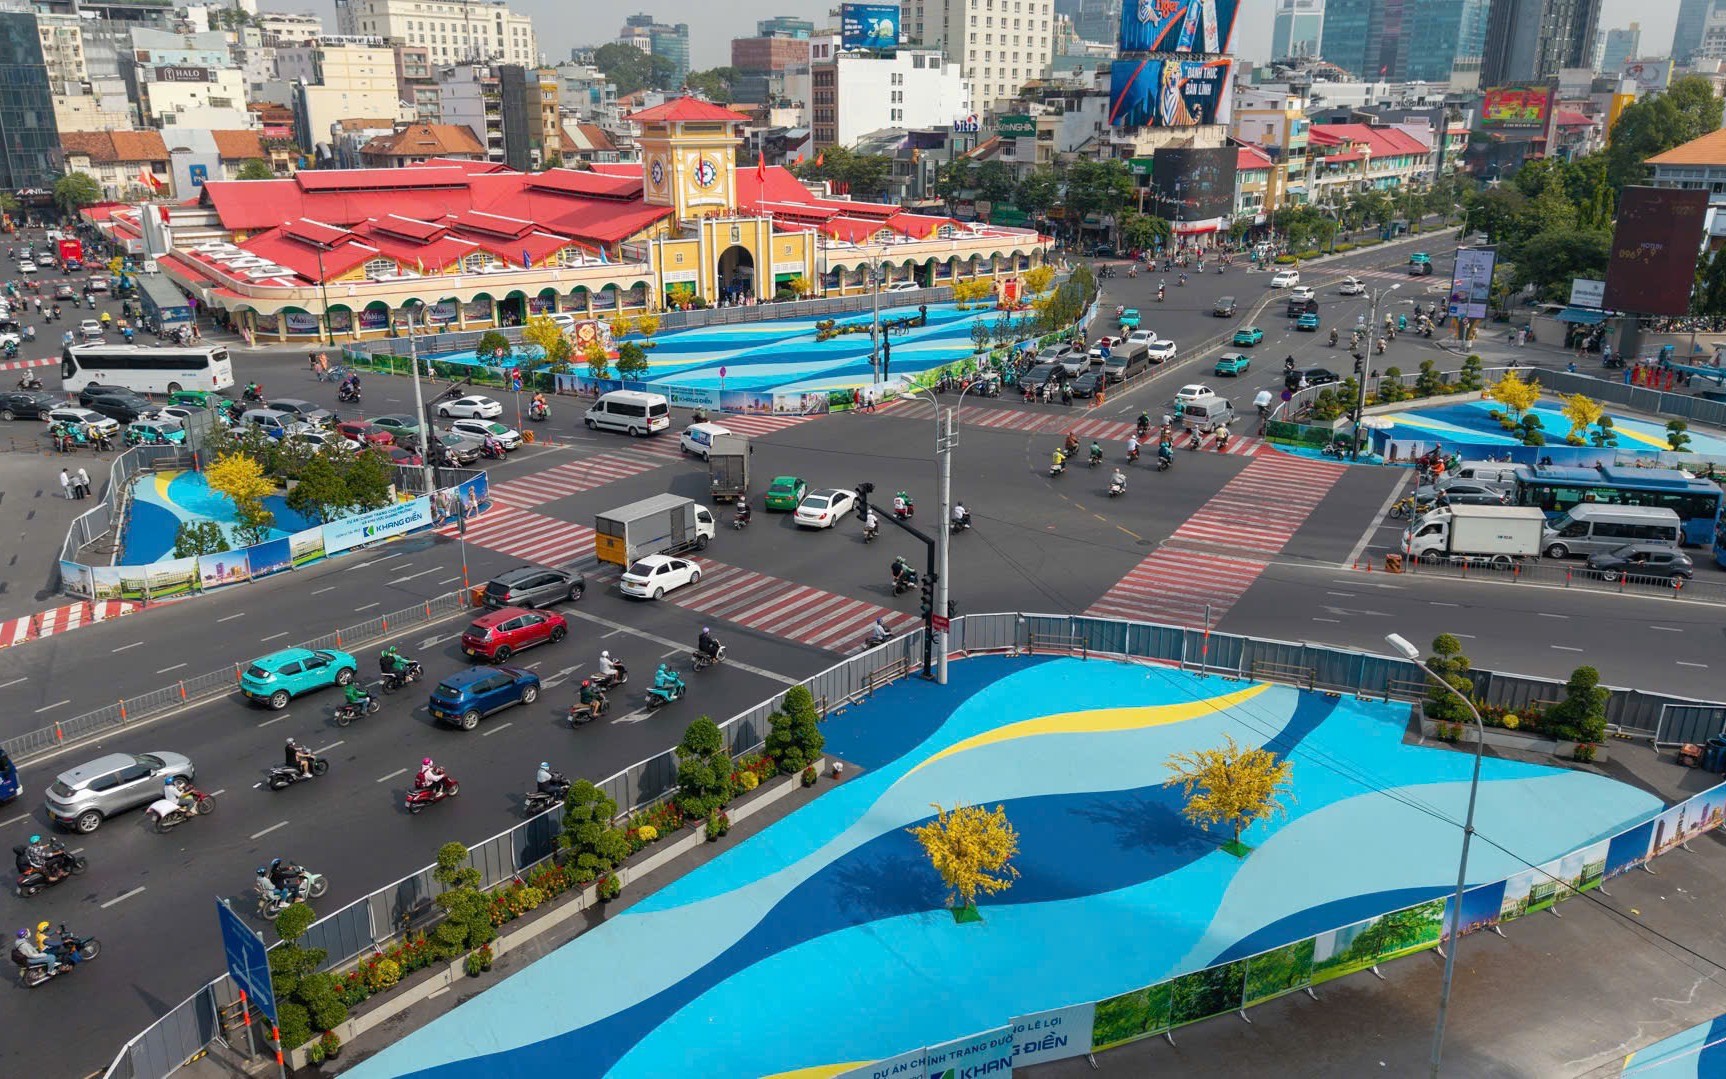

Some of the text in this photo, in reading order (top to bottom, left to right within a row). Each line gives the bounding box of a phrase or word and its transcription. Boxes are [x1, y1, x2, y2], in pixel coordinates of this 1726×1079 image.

[361, 311, 378, 320] Vikki
[376, 518, 405, 533] KHANG
[948, 1043, 987, 1060] TRANG
[1028, 1020, 1041, 1032] LÊ
[1044, 1017, 1062, 1029] LỢI
[1022, 1031, 1068, 1054] ĐIỀN
